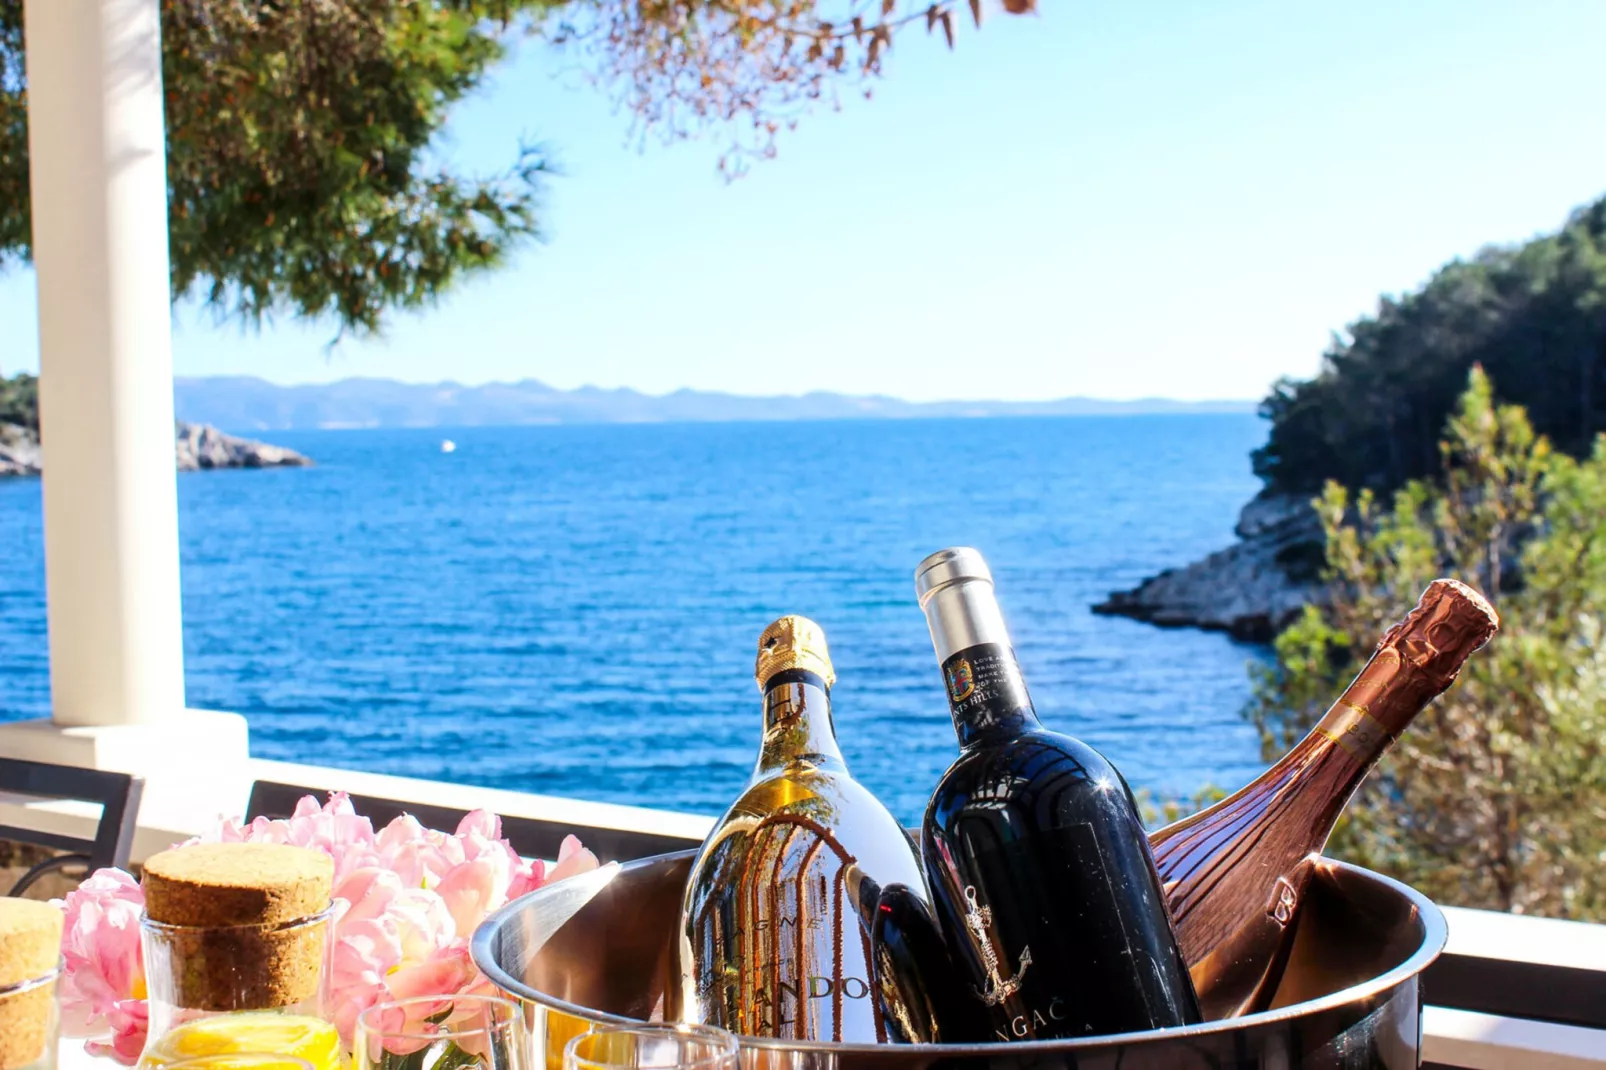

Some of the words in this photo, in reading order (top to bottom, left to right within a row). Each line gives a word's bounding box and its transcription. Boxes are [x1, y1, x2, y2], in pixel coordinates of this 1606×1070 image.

[973, 656, 993, 665] LOVE
[978, 670, 998, 679] MAKE
[970, 689, 999, 705] HILLS
[995, 996, 1067, 1042] NGAČ
